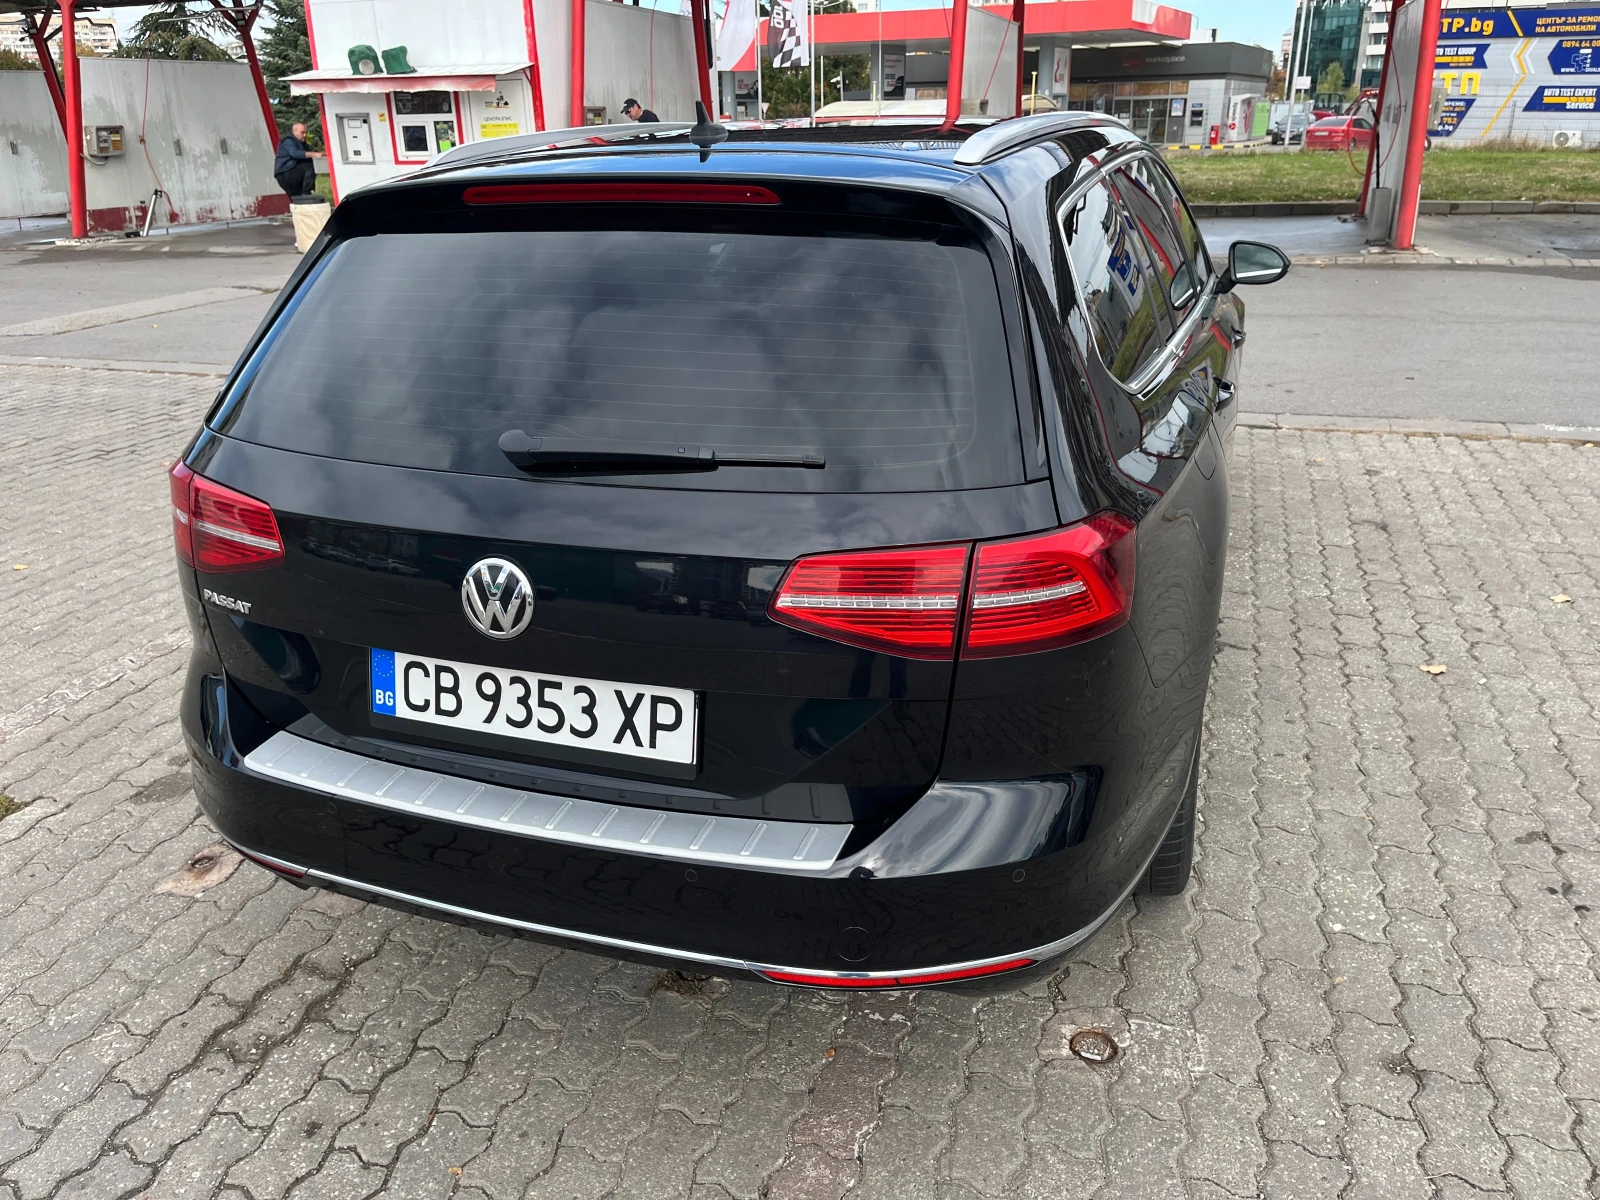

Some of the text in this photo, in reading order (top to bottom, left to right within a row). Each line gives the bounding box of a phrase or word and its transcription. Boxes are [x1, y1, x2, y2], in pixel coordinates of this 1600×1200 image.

[1536, 17, 1566, 25] ЦЕНТЪР
[1546, 24, 1597, 33] АВТОМОБИЛИ
[1543, 88, 1598, 97] AUTO TEST EXPERT
[1565, 101, 1595, 110] Service
[203, 588, 252, 615] PASSAT
[375, 688, 394, 706] BG
[403, 660, 683, 749] CB 9353 XP
